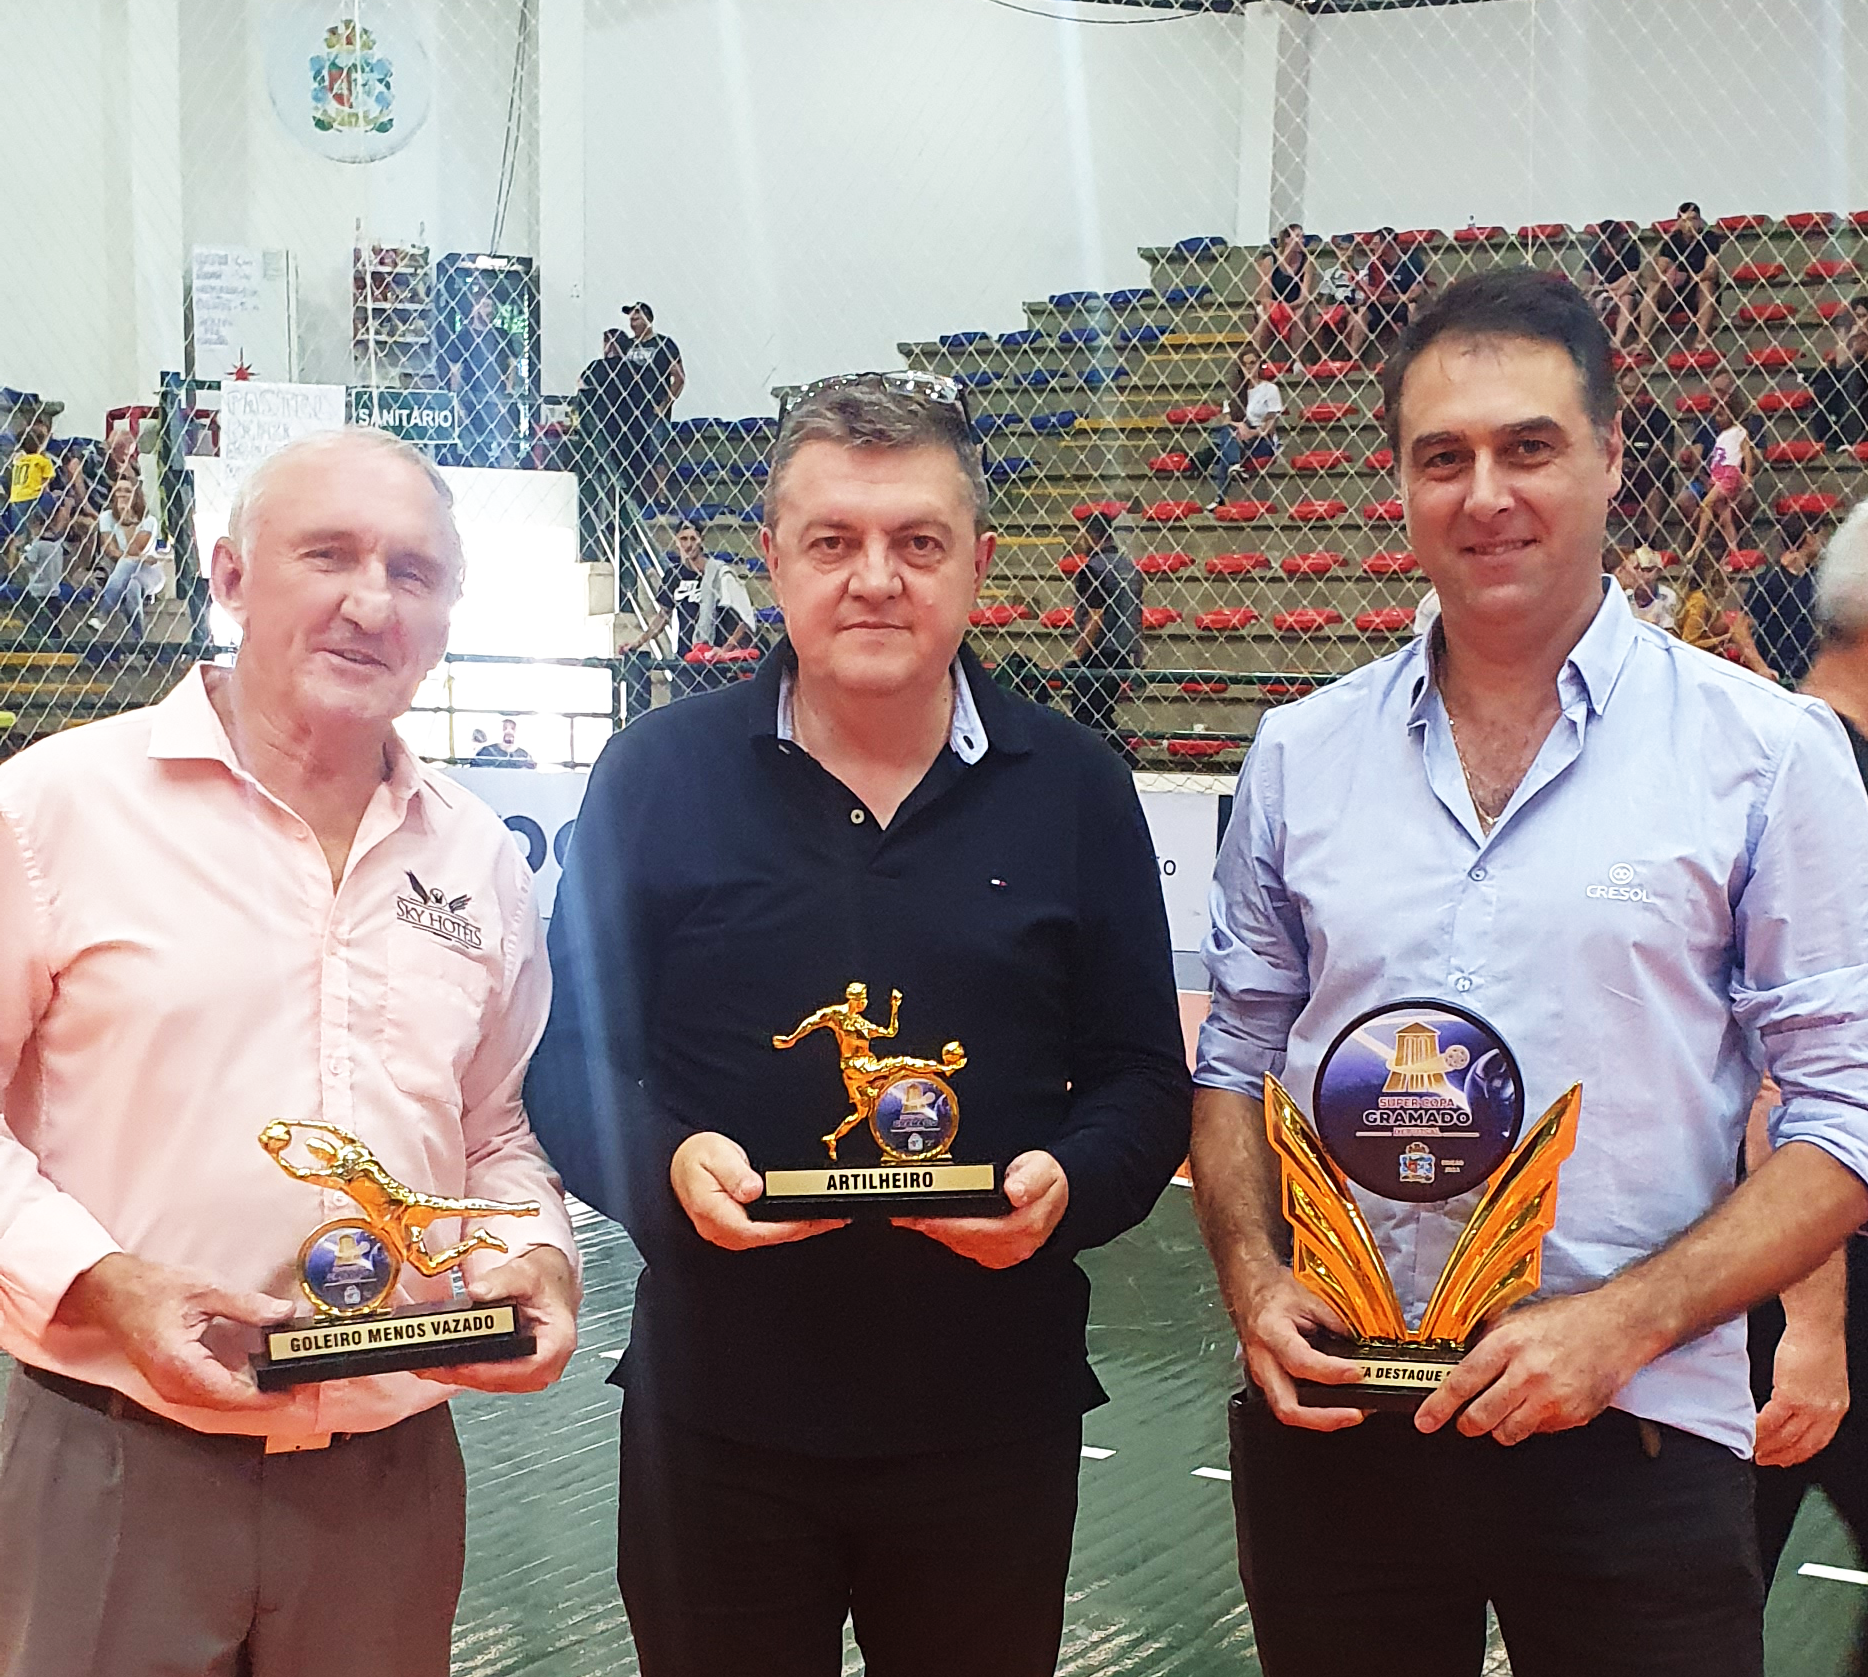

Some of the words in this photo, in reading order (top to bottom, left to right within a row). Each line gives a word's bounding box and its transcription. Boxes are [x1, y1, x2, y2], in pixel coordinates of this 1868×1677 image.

[1585, 884, 1653, 903] CRESOL
[396, 900, 425, 923] SKY
[429, 912, 482, 947] HOTELS
[1379, 1097, 1419, 1109] SUPER
[1421, 1097, 1456, 1109] COPA
[1363, 1110, 1473, 1126] GRAMADO
[826, 1171, 934, 1191] ARTILHEIRO
[290, 1328, 362, 1353] GOLEIRO
[367, 1322, 426, 1344] MENOS
[430, 1314, 495, 1335] VAZADO
[1375, 1367, 1443, 1382] DESTAQUE
